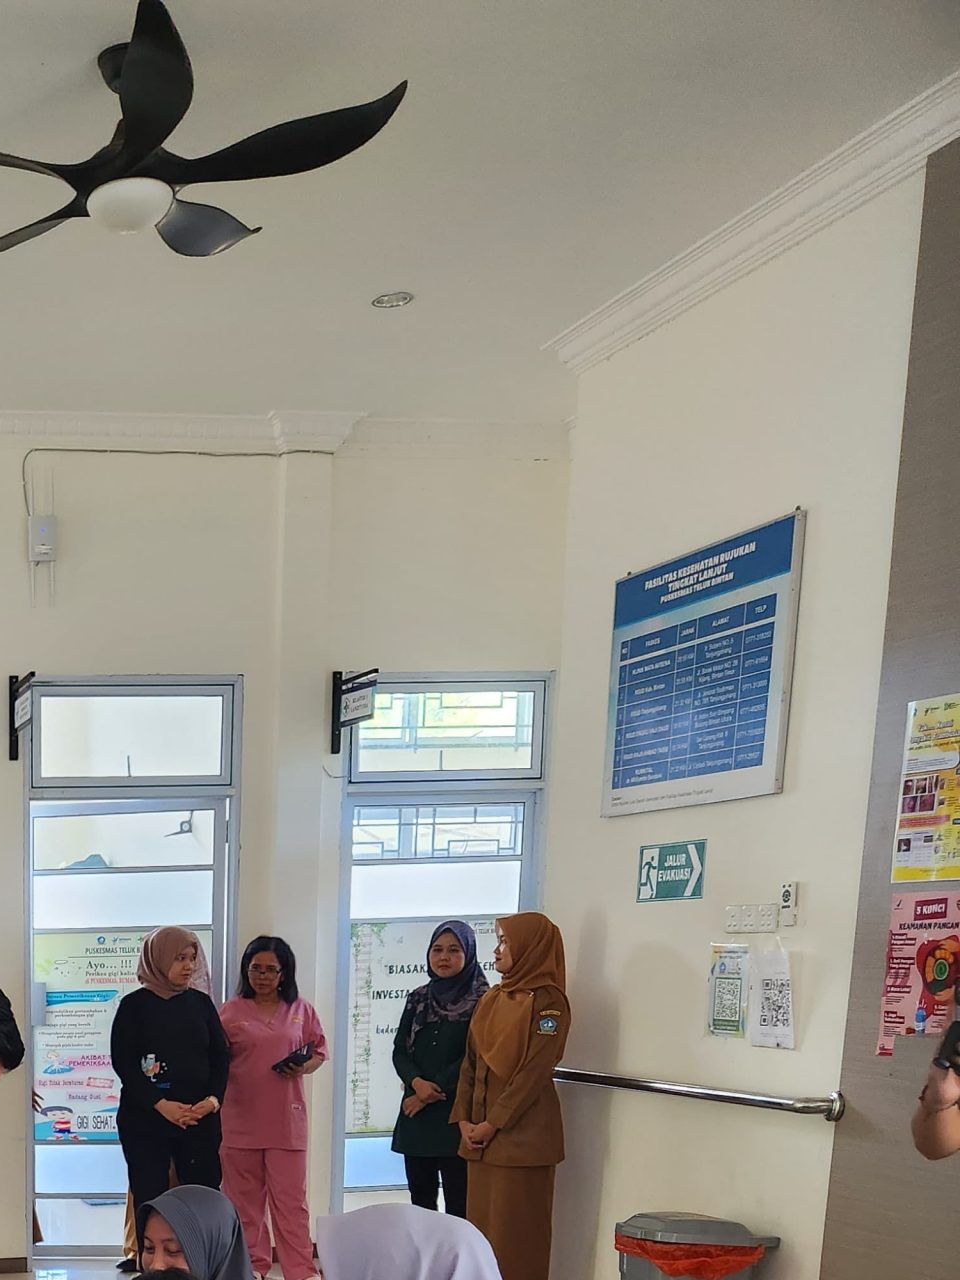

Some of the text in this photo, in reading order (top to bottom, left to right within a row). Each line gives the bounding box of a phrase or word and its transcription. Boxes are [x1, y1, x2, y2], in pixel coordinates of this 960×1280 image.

[644, 542, 756, 590] FASILITAS KESEHATAN RUJUKAN
[668, 564, 728, 592] TINGKAT LANJUT
[660, 572, 734, 604] PUSKESMAS TELUK BINTAN
[712, 616, 730, 626] ALAMAT
[754, 604, 768, 614] TELP
[664, 854, 686, 866] JALUR
[658, 868, 690, 882] EVAKUASI
[923, 904, 945, 914] KUNCI
[87, 960, 132, 971] Ayo... !!!
[384, 964, 428, 974] "BIASAK
[77, 1115, 116, 1129] GIGI SEHAT.
